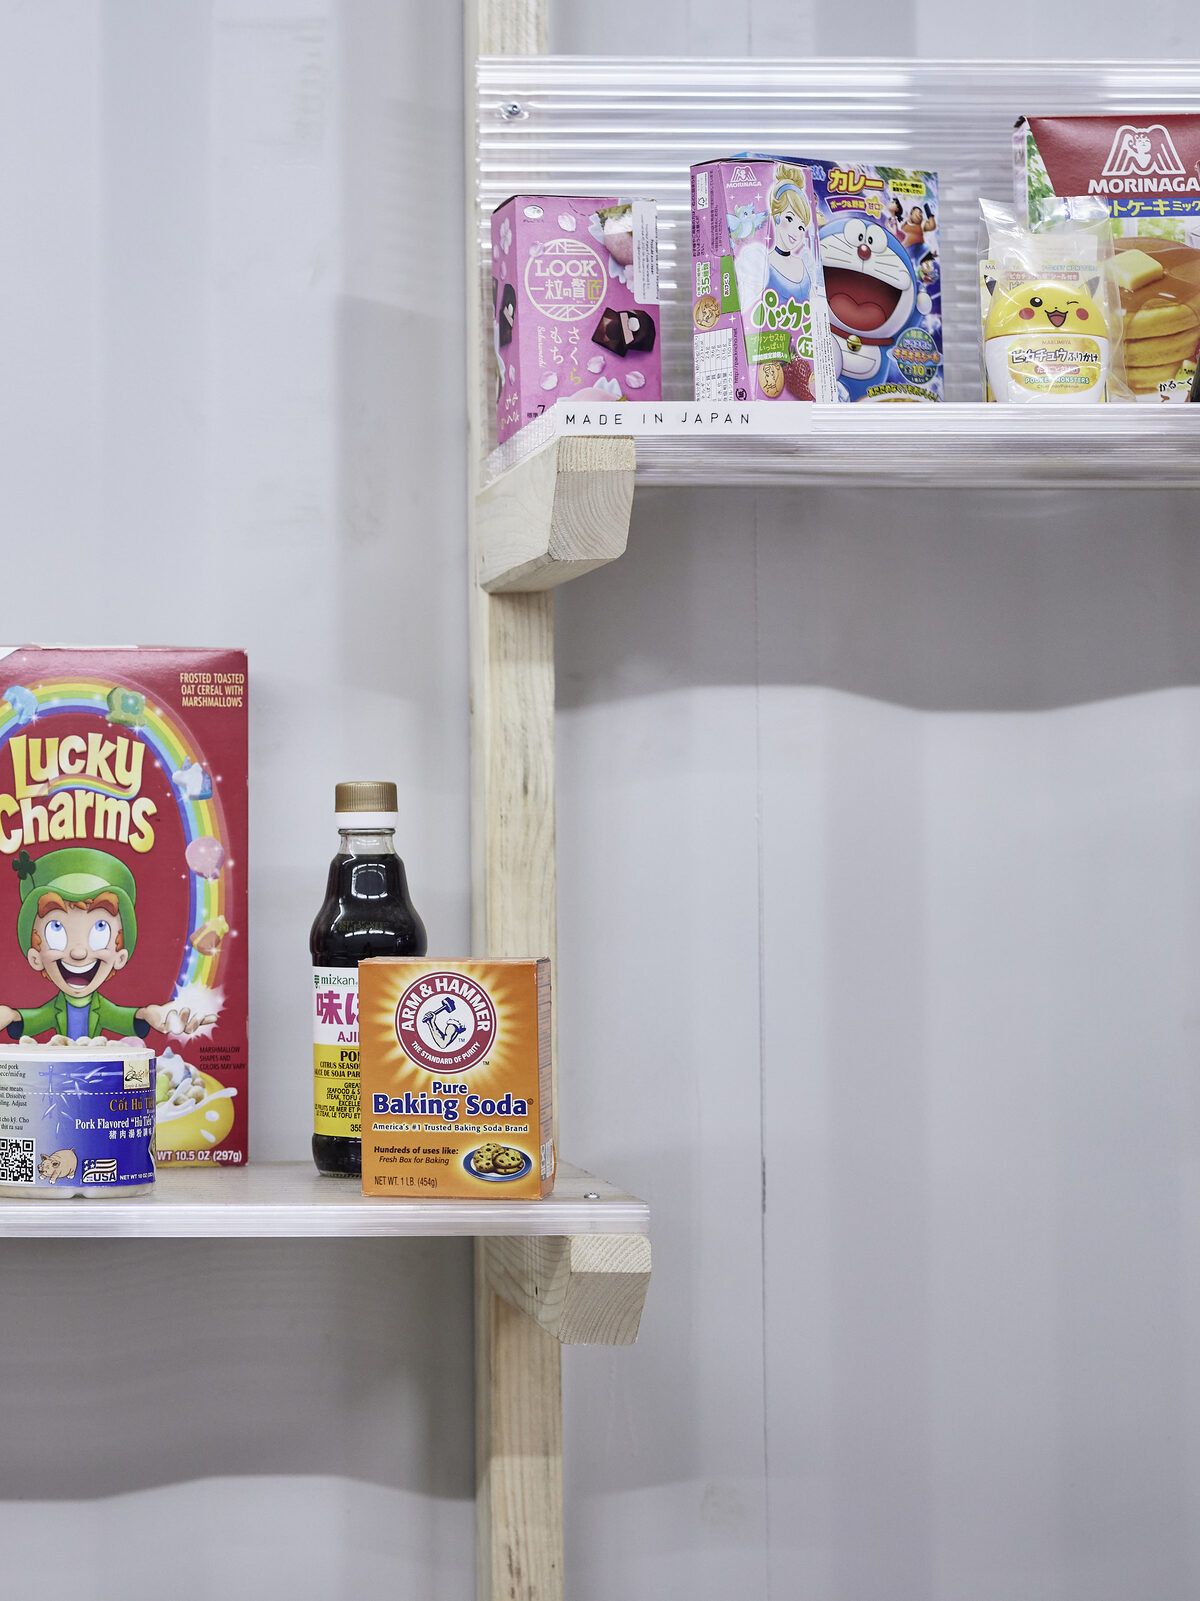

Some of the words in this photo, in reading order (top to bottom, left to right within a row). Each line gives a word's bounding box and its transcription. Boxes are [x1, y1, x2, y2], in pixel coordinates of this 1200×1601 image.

[726, 181, 762, 189] MORINAGA
[828, 168, 884, 193] カレー
[1088, 177, 1200, 193] MORINAGA
[535, 259, 597, 276] LOOK
[550, 326, 564, 364] もち
[568, 326, 581, 384] さくら
[566, 413, 623, 426] MADE
[643, 412, 663, 424] IN
[681, 412, 750, 424] JAPAN
[180, 672, 211, 683] FROSTED
[214, 673, 245, 684] TOASTED
[181, 685, 195, 695] OAT
[197, 685, 223, 695] CEREAL
[225, 685, 243, 695] WITH
[182, 696, 243, 707] MARSHMALLOWS
[9, 733, 145, 800] Lucky
[321, 974, 355, 986] mizkan
[401, 992, 423, 1032] ARM
[419, 983, 435, 998] &
[435, 977, 491, 1032] HAMMER
[411, 1040, 422, 1054] THE
[420, 1050, 453, 1065] STANDARD
[453, 1055, 463, 1063] OF
[462, 1041, 481, 1060] PURITY
[320, 1061, 337, 1069] CITRUS
[326, 1087, 350, 1095] SEAFOOD
[432, 1081, 468, 1095] Pure
[373, 1092, 459, 1121] Baking
[465, 1092, 528, 1116] Soda
[75, 1119, 95, 1130] Pork
[97, 1118, 129, 1130] Flavored
[373, 1123, 410, 1131] America's
[454, 1124, 481, 1133] Baking
[157, 1151, 172, 1160] WT
[175, 1151, 195, 1160] 10.5
[198, 1151, 210, 1160] OZ
[212, 1150, 242, 1162] (297g)
[374, 1146, 410, 1154] Hundreds
[412, 1146, 421, 1154] of
[441, 1146, 459, 1155] like:
[399, 1156, 413, 1164] Box
[413, 1156, 424, 1164] for
[425, 1157, 450, 1166] Baking
[94, 1172, 116, 1181] USA
[374, 1176, 386, 1186] NET
[388, 1176, 399, 1186] WT.
[406, 1177, 416, 1186] LB.
[417, 1177, 438, 1188] (454g)
